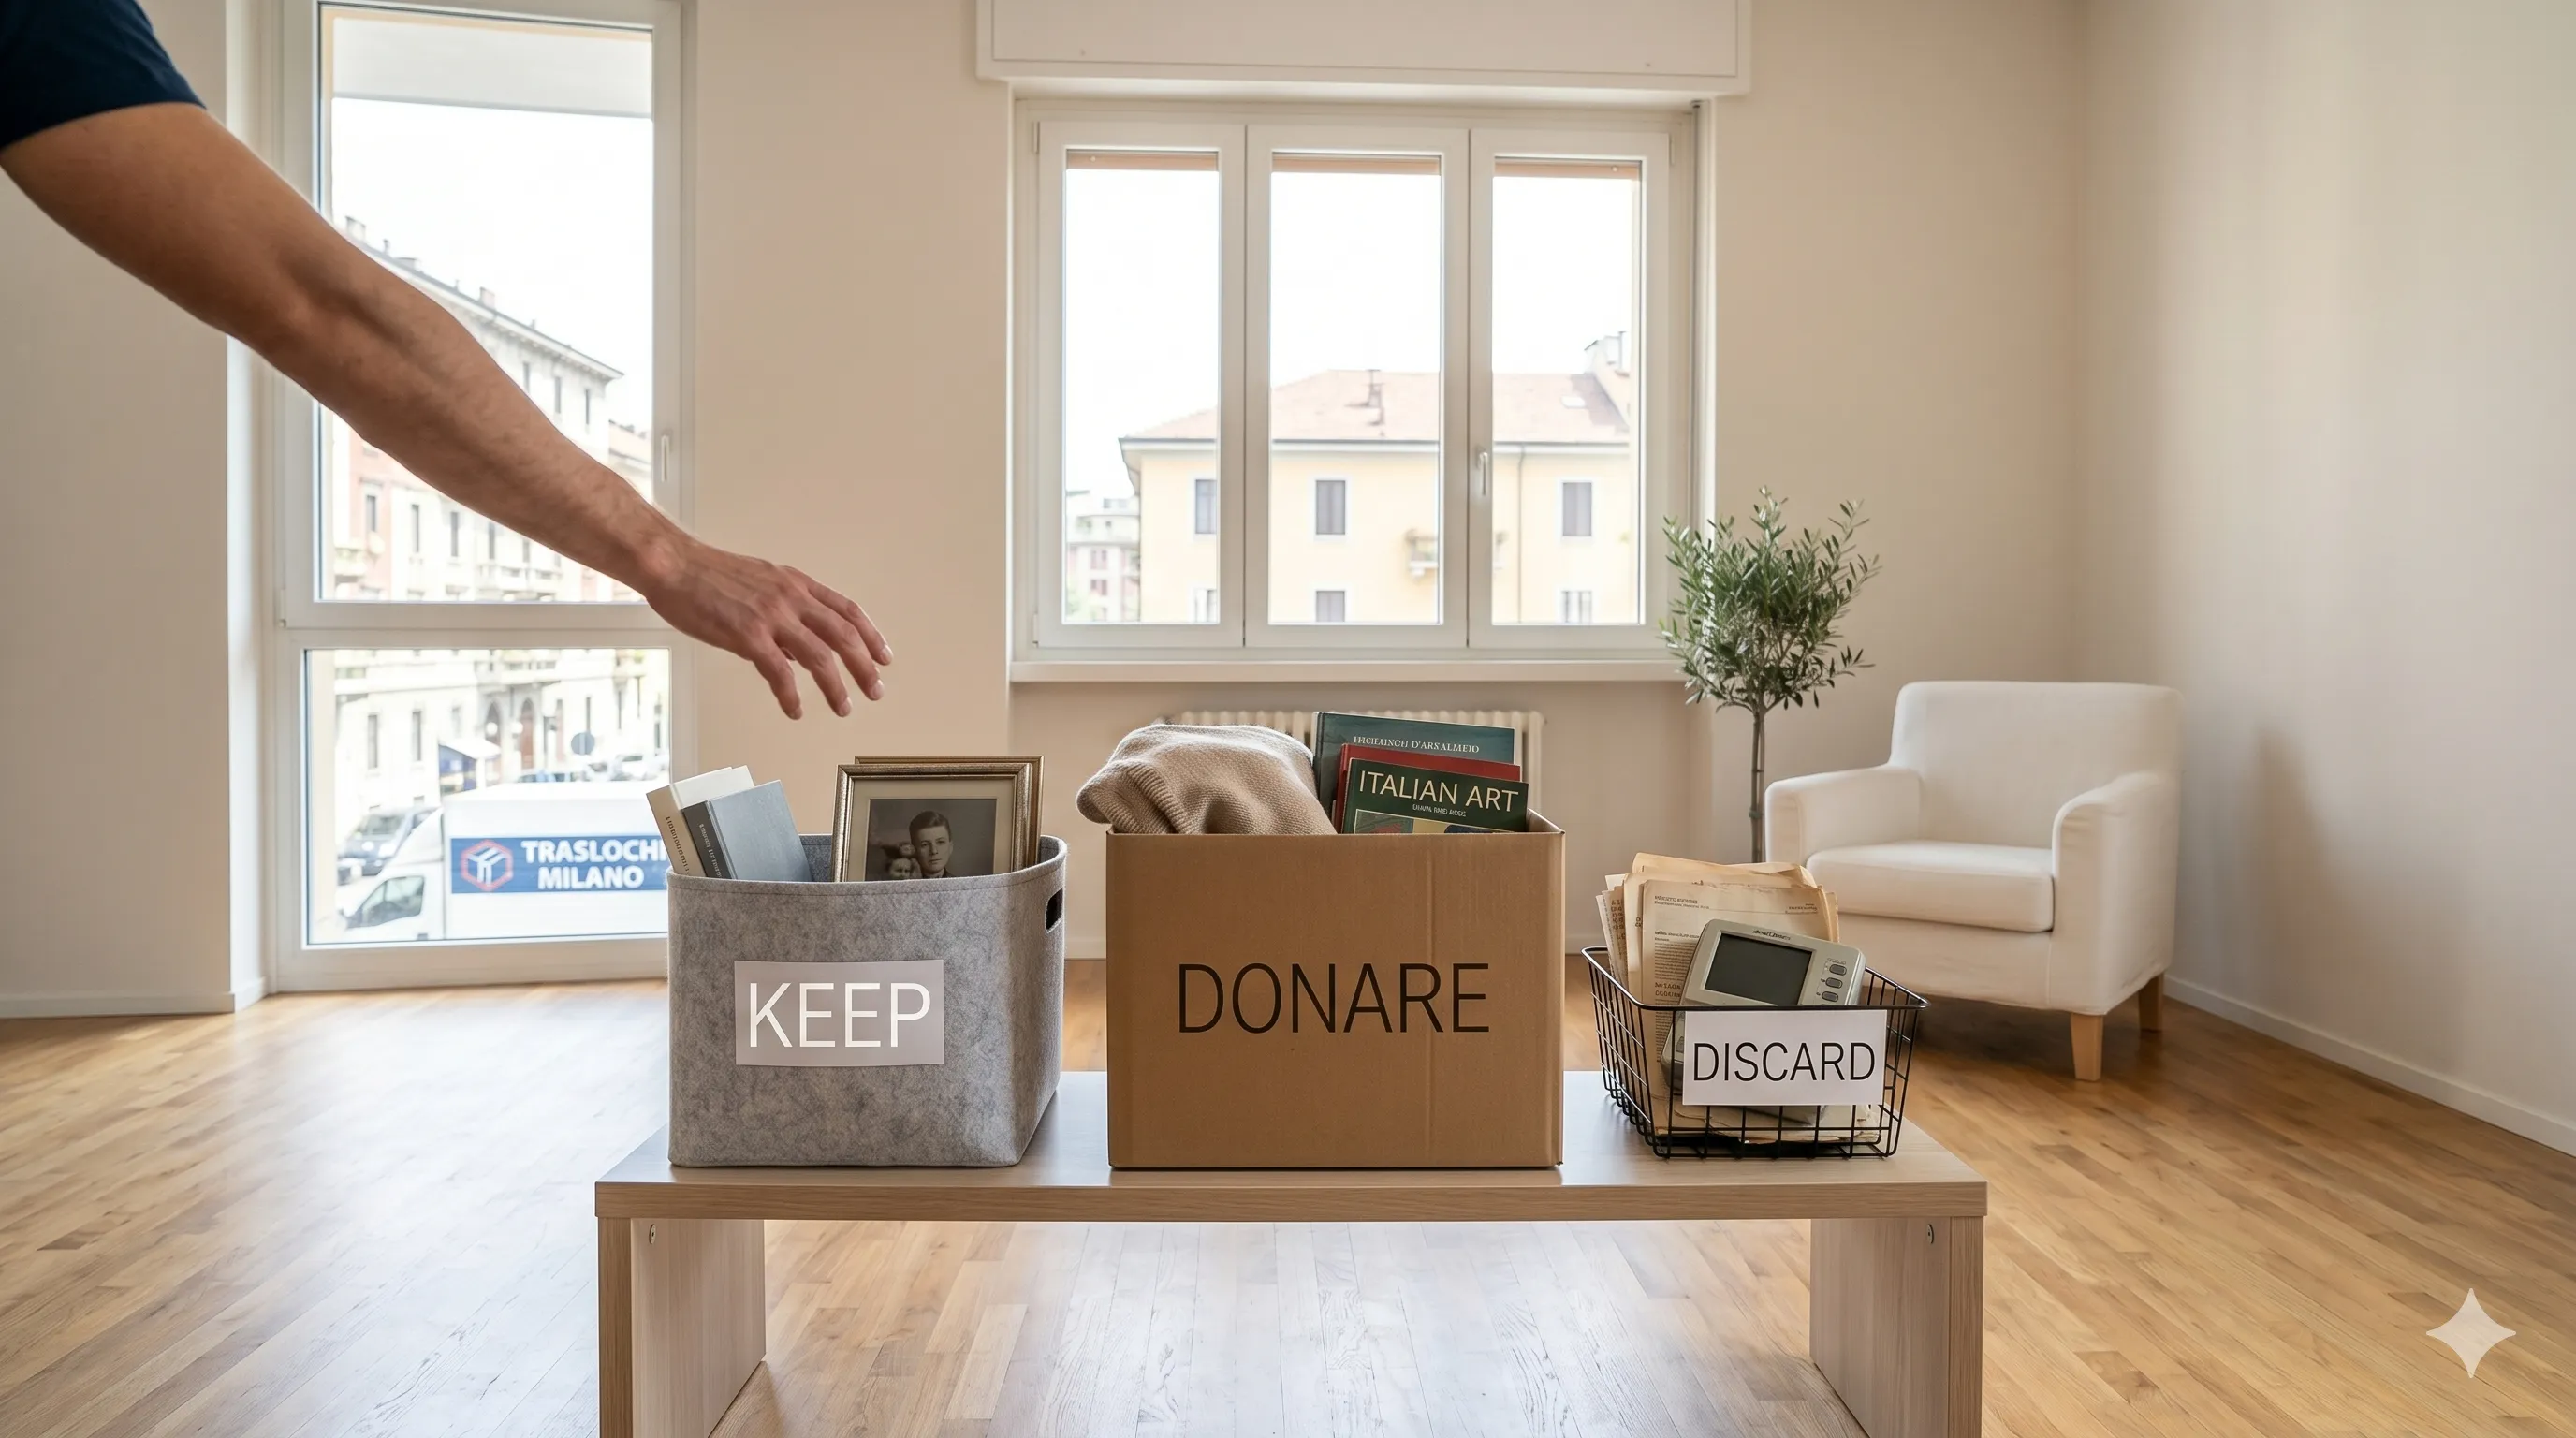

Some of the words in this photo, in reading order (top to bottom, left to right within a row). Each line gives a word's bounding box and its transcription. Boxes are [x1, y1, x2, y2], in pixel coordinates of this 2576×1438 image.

[1358, 770, 1458, 805] ITALIAN
[1465, 785, 1519, 813] ART
[520, 839, 667, 863] TRASLOCHI
[537, 865, 645, 889] MILANO
[749, 982, 931, 1048] KEEP
[1178, 962, 1490, 1034] DONARE
[1693, 1041, 1875, 1082] DISCARD
